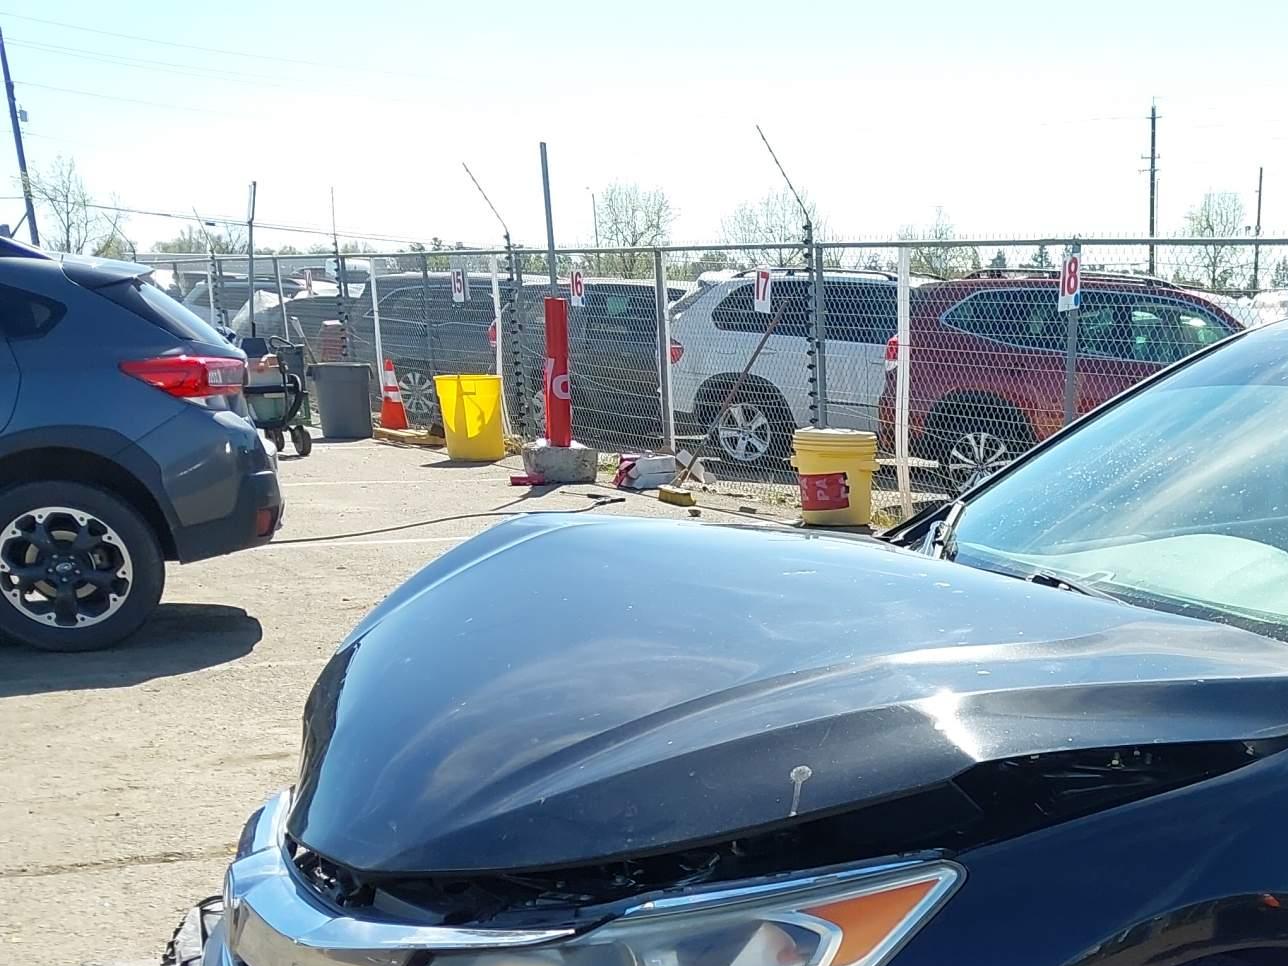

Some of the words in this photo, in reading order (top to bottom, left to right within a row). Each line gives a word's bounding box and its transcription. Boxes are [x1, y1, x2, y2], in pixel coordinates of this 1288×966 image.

[452, 271, 463, 294] 15
[571, 271, 583, 297] 16
[756, 270, 770, 301] 17
[1061, 256, 1078, 297] 18
